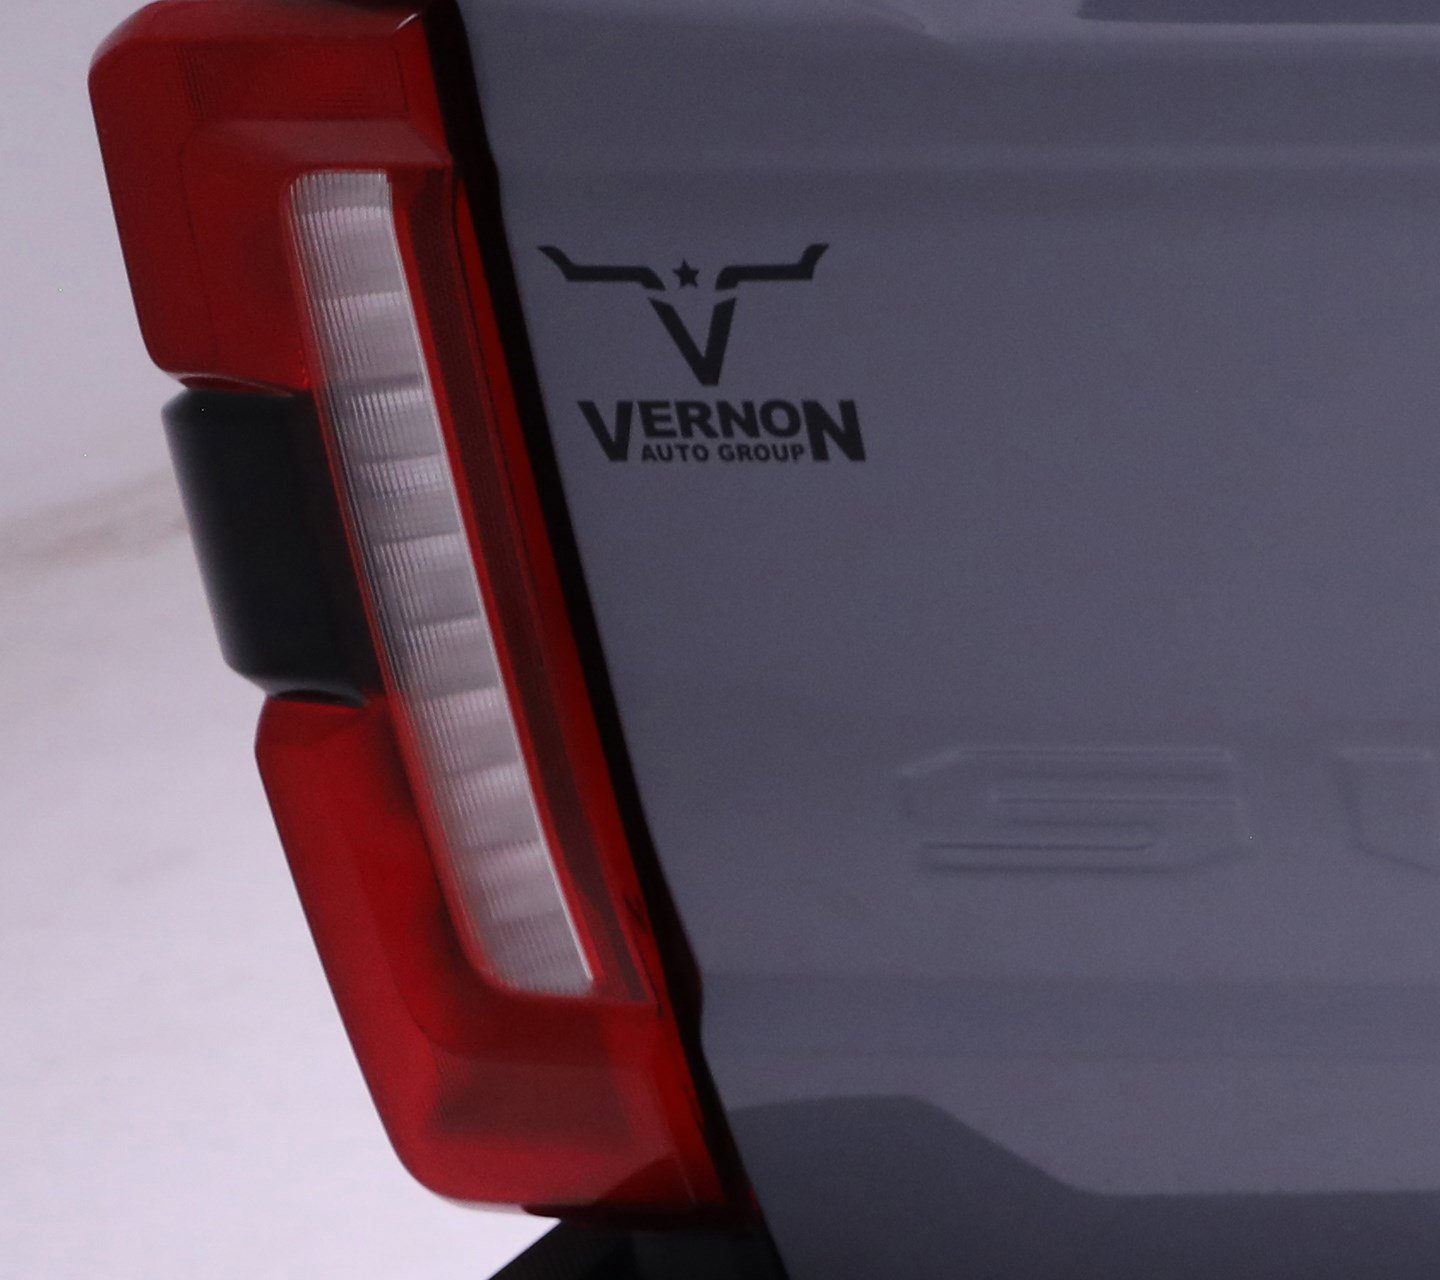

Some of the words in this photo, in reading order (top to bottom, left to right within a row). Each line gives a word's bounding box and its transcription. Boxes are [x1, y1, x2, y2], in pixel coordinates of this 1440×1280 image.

[576, 399, 868, 463] VERNON
[640, 442, 710, 463] AUTO
[717, 442, 808, 463] GROUP
